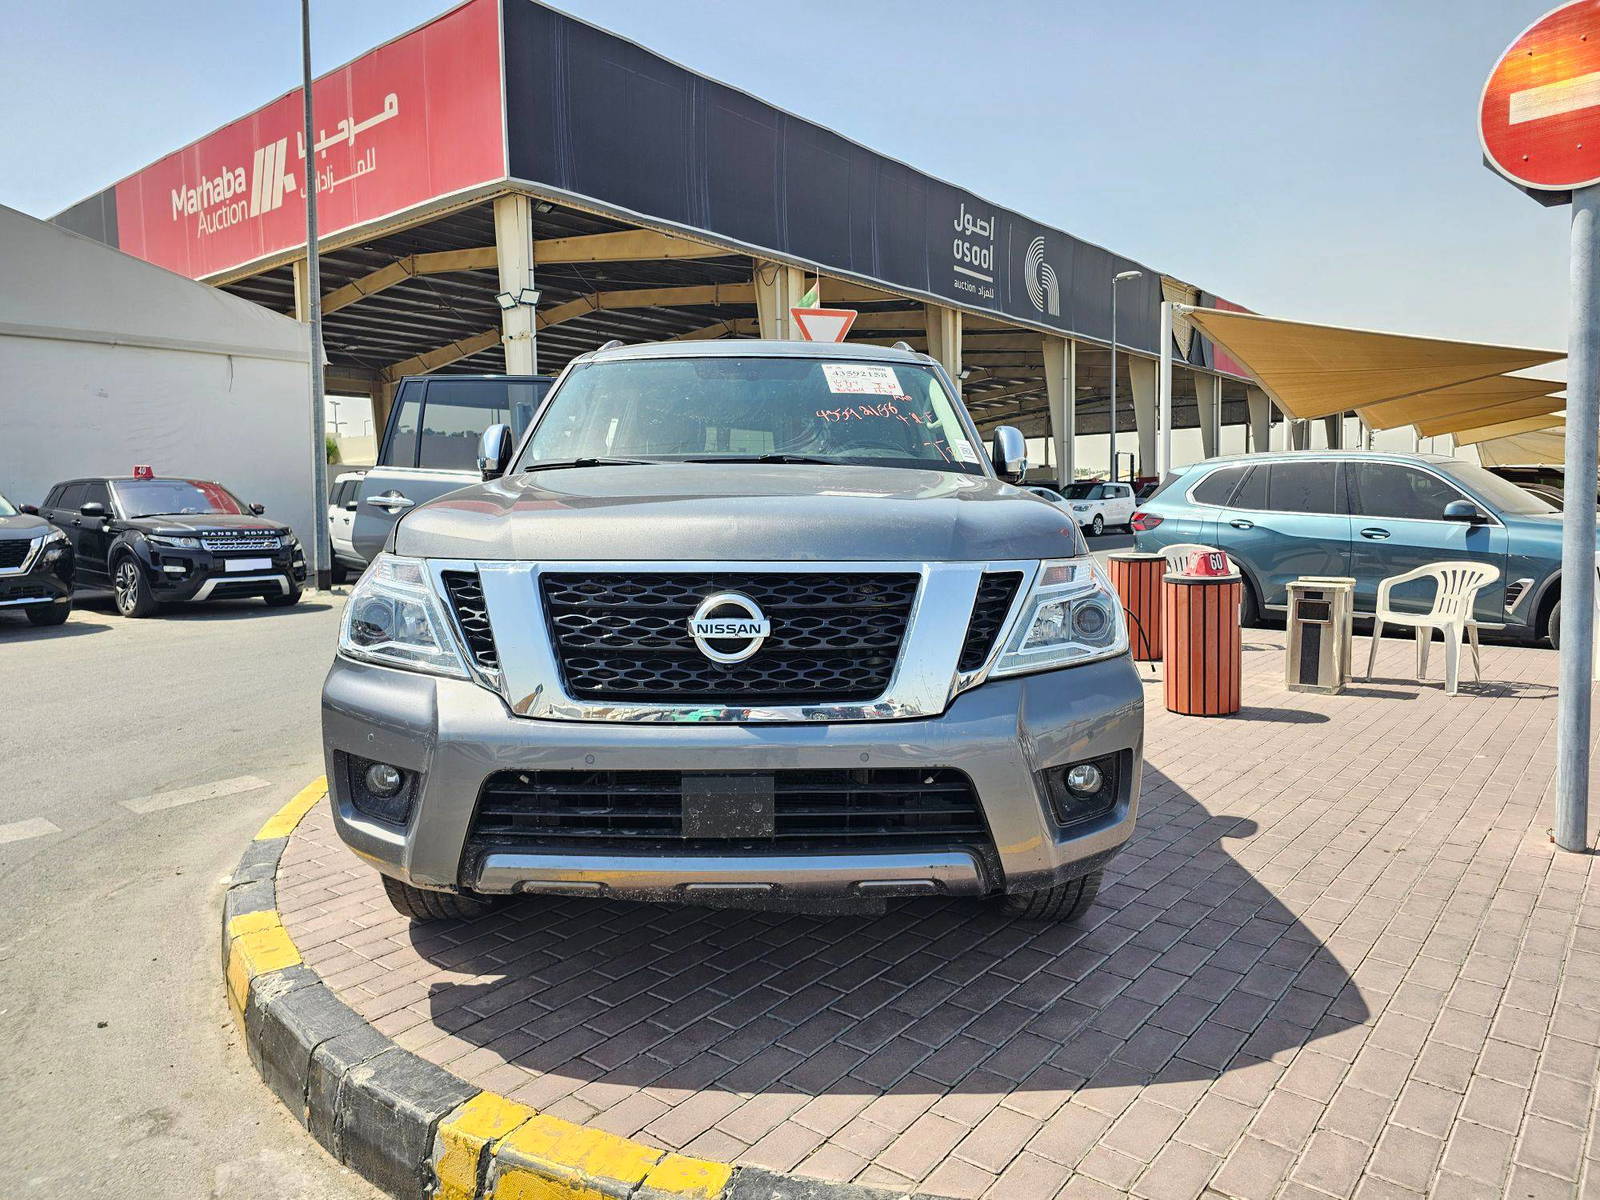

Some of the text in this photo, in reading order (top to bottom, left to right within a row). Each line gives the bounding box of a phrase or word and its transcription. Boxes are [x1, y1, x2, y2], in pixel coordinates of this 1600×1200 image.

[297, 92, 399, 160] مرحبا
[171, 165, 247, 222] Marhaba
[197, 200, 249, 240] Auction
[953, 202, 995, 241] اصول
[953, 279, 977, 293] auction
[1210, 553, 1223, 570] 60
[696, 623, 761, 635] NISSAN
